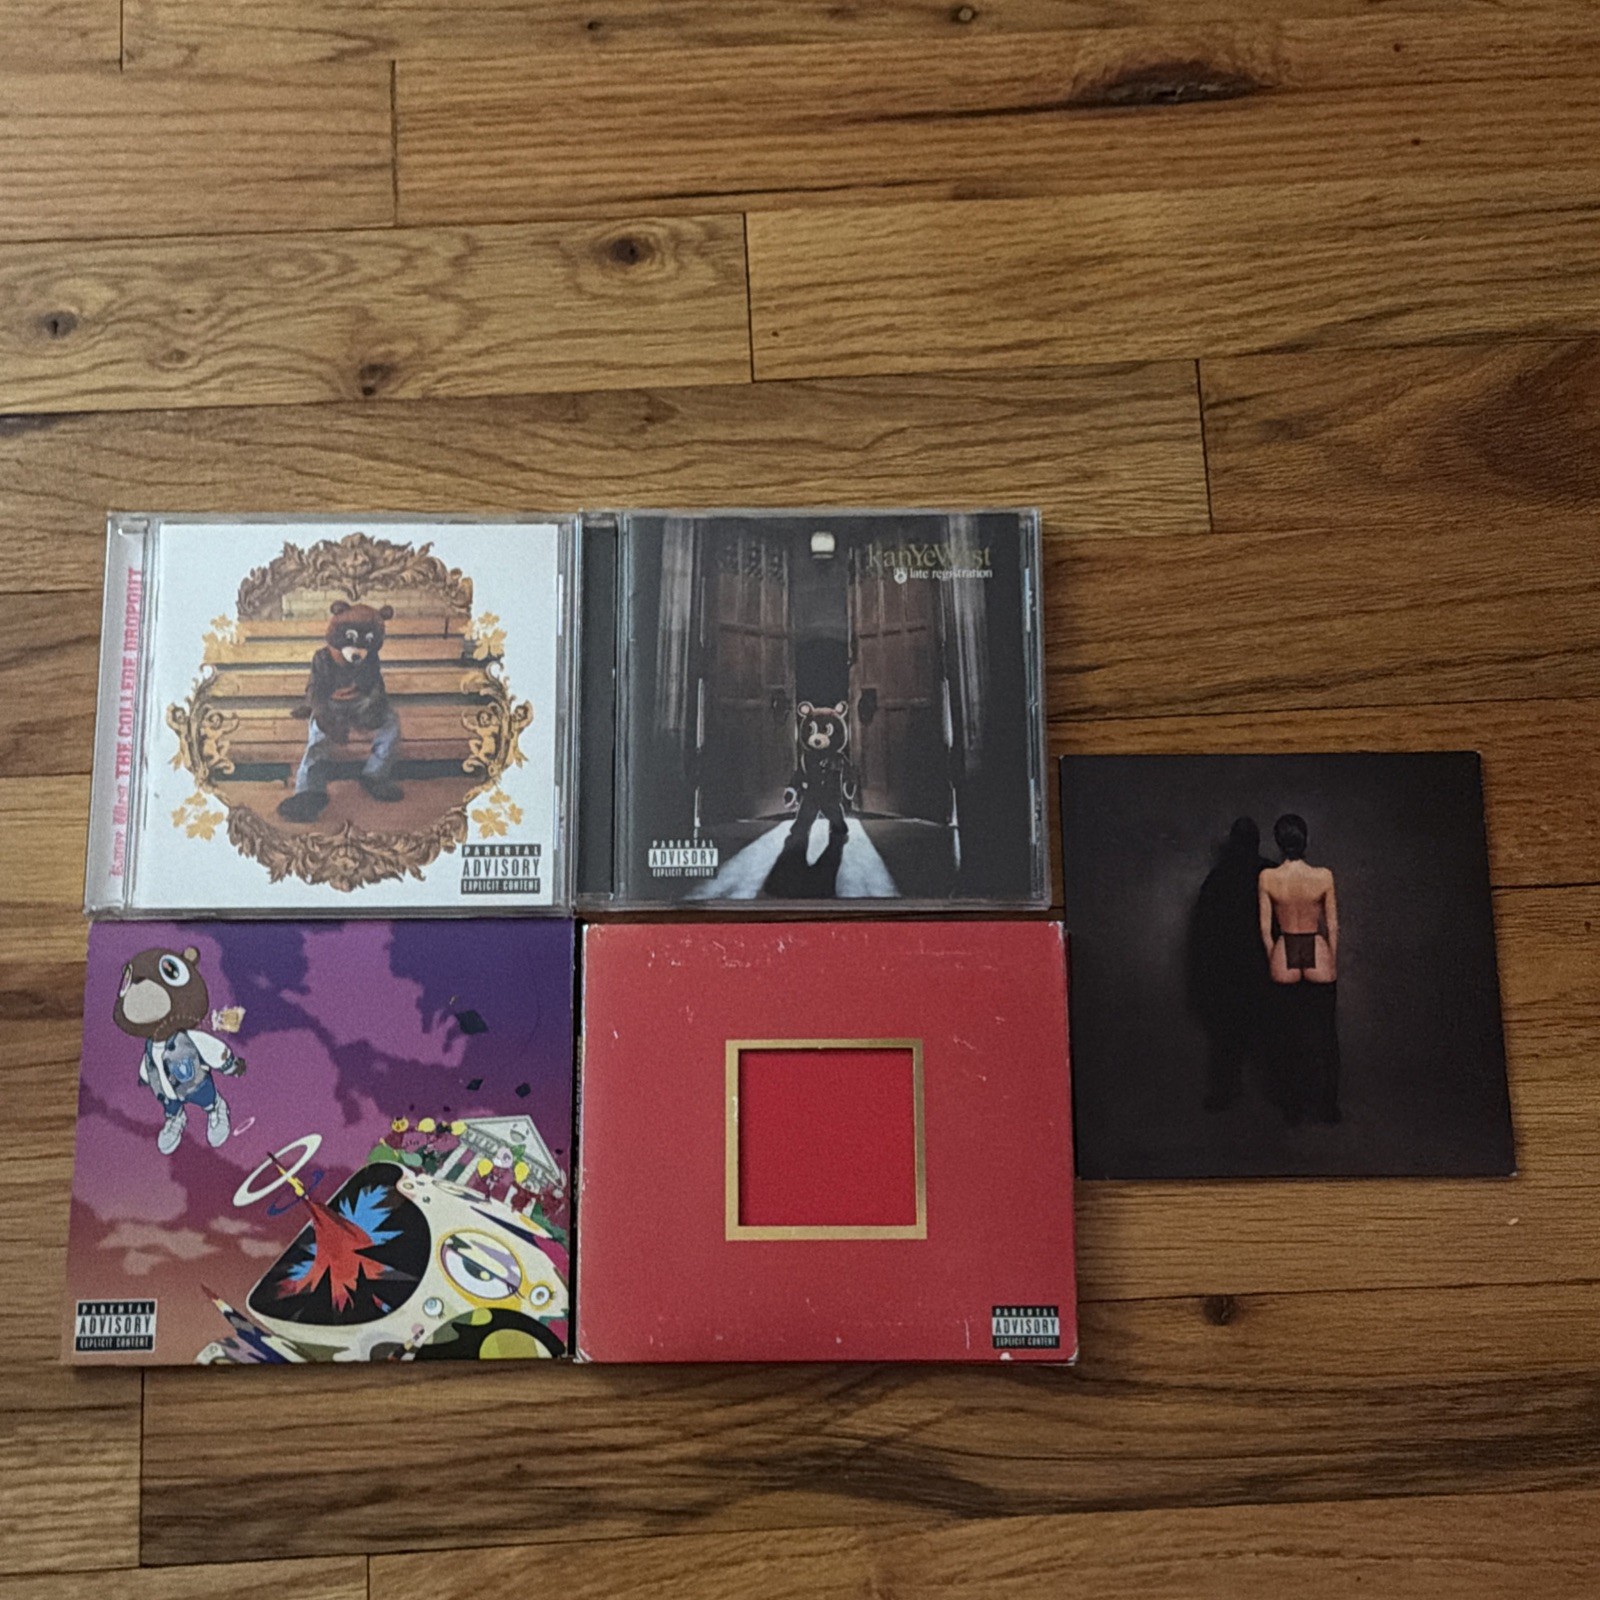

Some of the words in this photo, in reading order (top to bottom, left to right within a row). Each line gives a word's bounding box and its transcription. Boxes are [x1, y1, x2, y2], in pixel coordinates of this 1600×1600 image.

[909, 569, 929, 579] late
[123, 567, 143, 651] DROPOUT
[115, 742, 132, 779] THE
[652, 839, 714, 848] PARENTAL
[465, 846, 538, 856] PARENTAL
[652, 850, 714, 866] ADVISORY
[462, 858, 540, 877] ADVISORY
[652, 868, 682, 877] EXPLICIT
[684, 868, 714, 877] CONTENT
[463, 880, 500, 892] EXPLICIT
[503, 880, 539, 891] CONTENT
[82, 1303, 150, 1315] PARENTAL
[995, 1308, 1056, 1316] PARENTAL
[80, 1316, 151, 1335] ADVISORY
[995, 1318, 1056, 1334] ADVISORY
[80, 1337, 113, 1349] EXPLICIT
[116, 1337, 149, 1348] CONTENT
